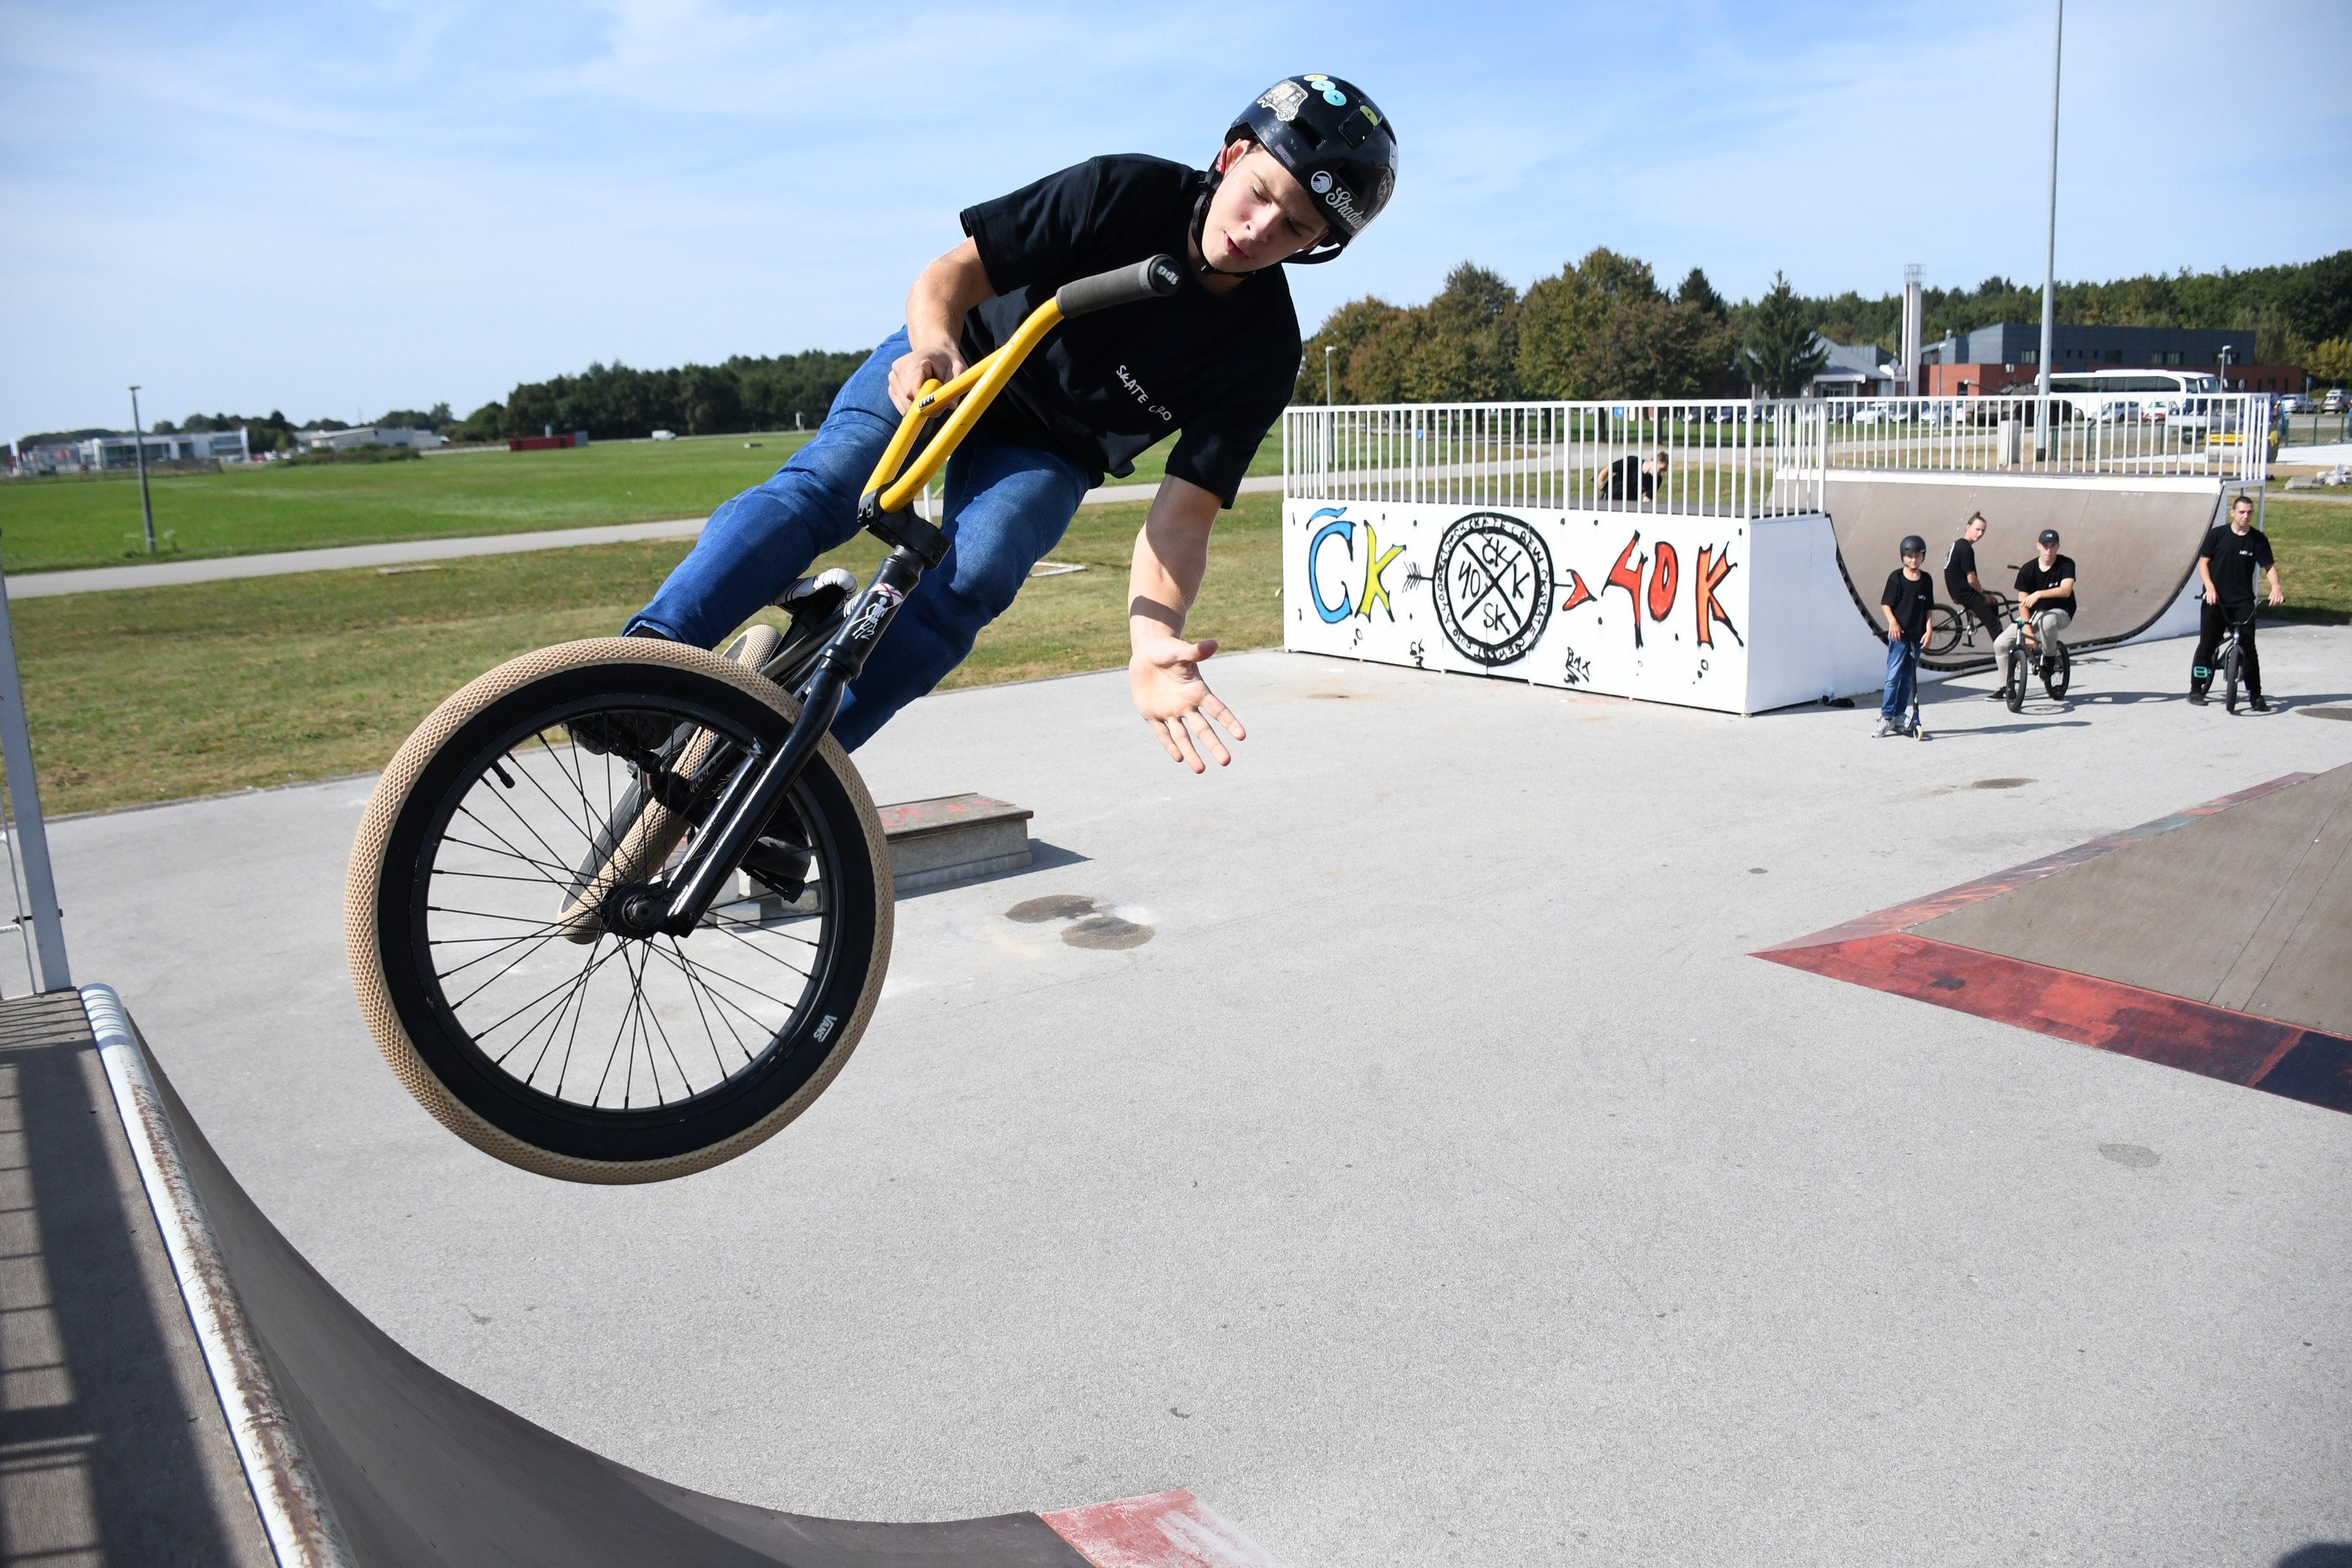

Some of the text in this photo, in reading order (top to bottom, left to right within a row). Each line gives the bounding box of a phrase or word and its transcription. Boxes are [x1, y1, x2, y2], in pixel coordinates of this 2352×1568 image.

[1116, 364, 1173, 421] SKATE CRO
[1512, 563, 1531, 600] K
[1601, 529, 1745, 651] 40K
[813, 1015, 837, 1043] VANS
